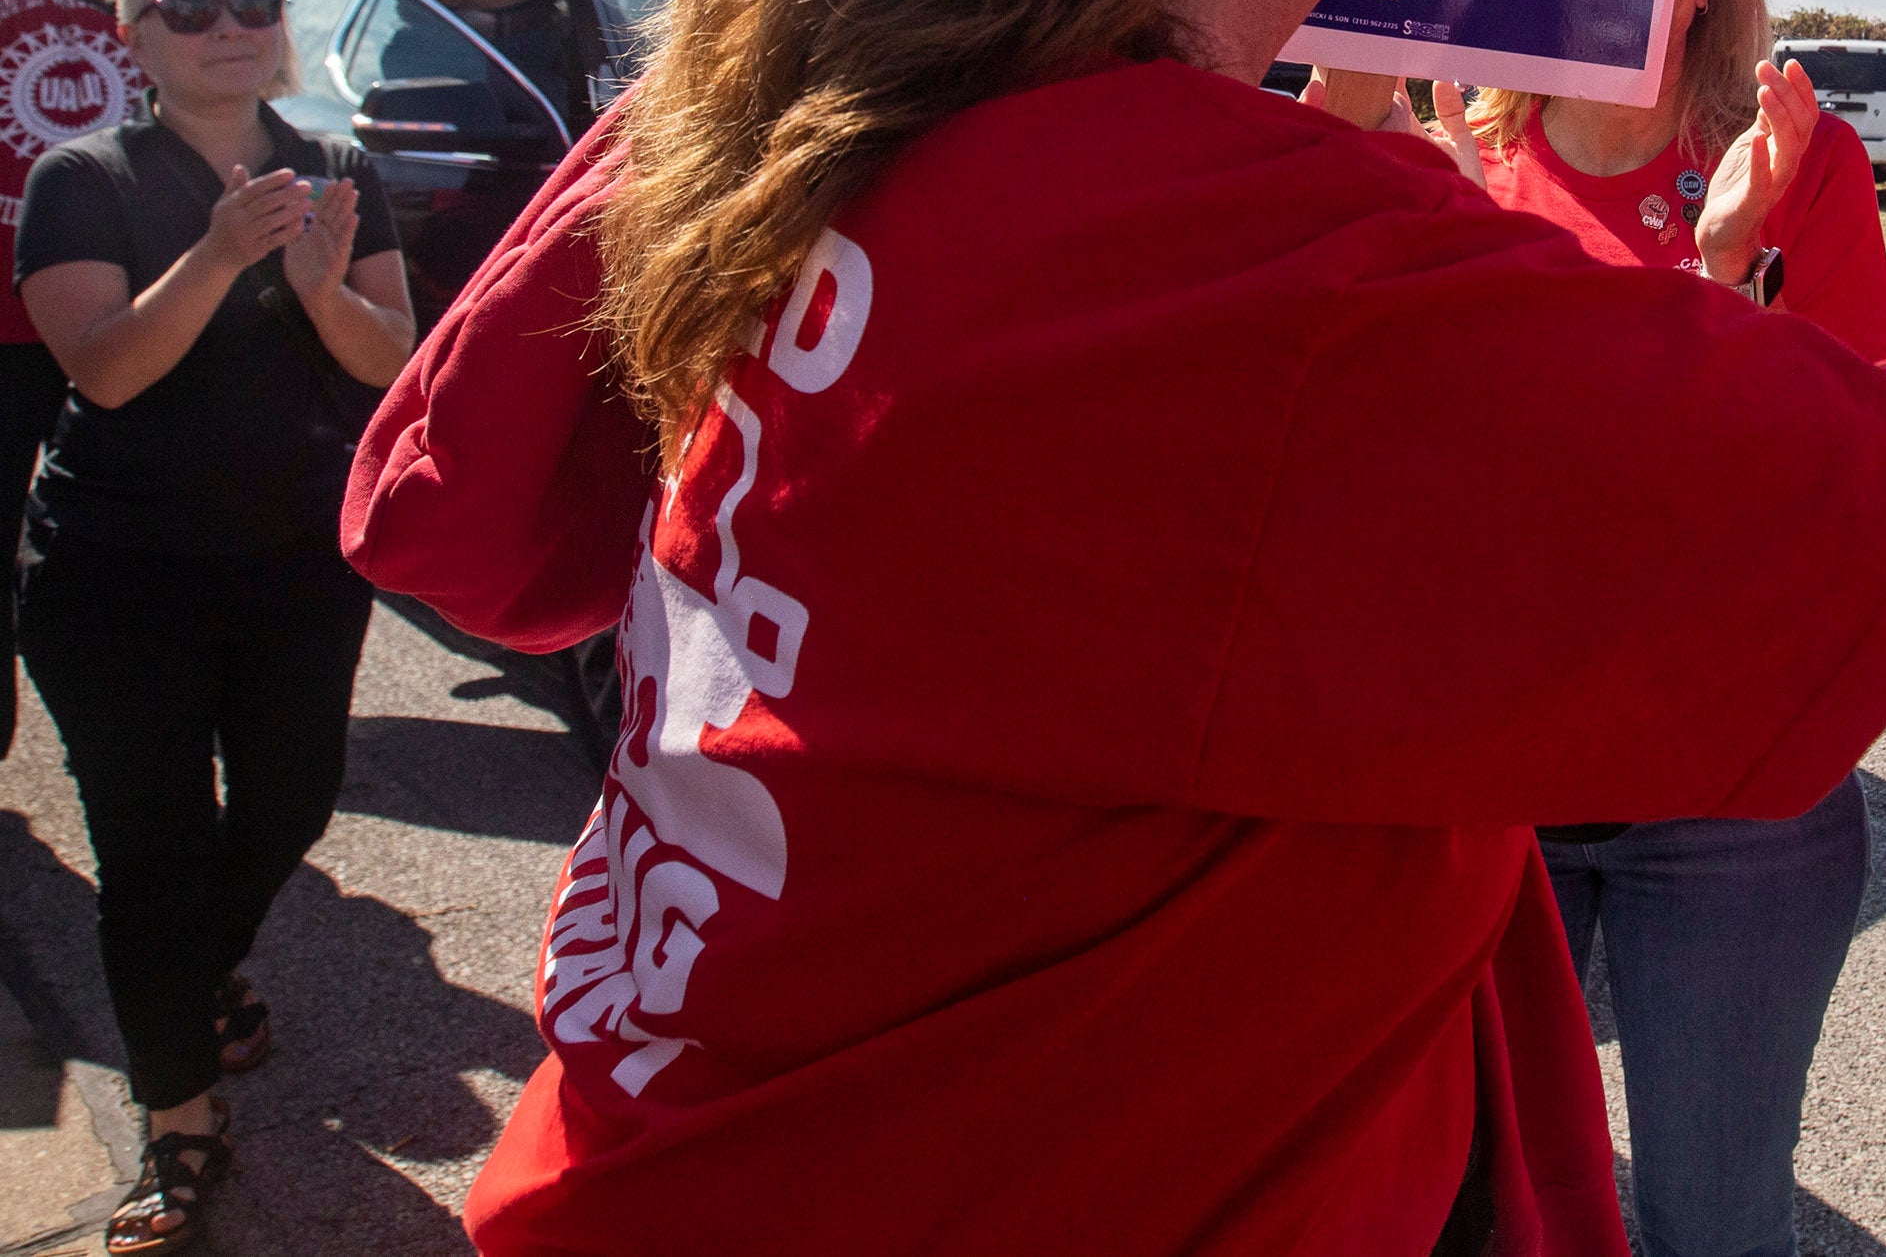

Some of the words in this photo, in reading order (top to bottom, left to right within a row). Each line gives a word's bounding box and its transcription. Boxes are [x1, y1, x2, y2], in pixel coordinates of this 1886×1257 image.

[1327, 13, 1334, 22] &
[1334, 14, 1350, 24] SON
[40, 73, 103, 112] UAW
[1642, 214, 1664, 230] CWA
